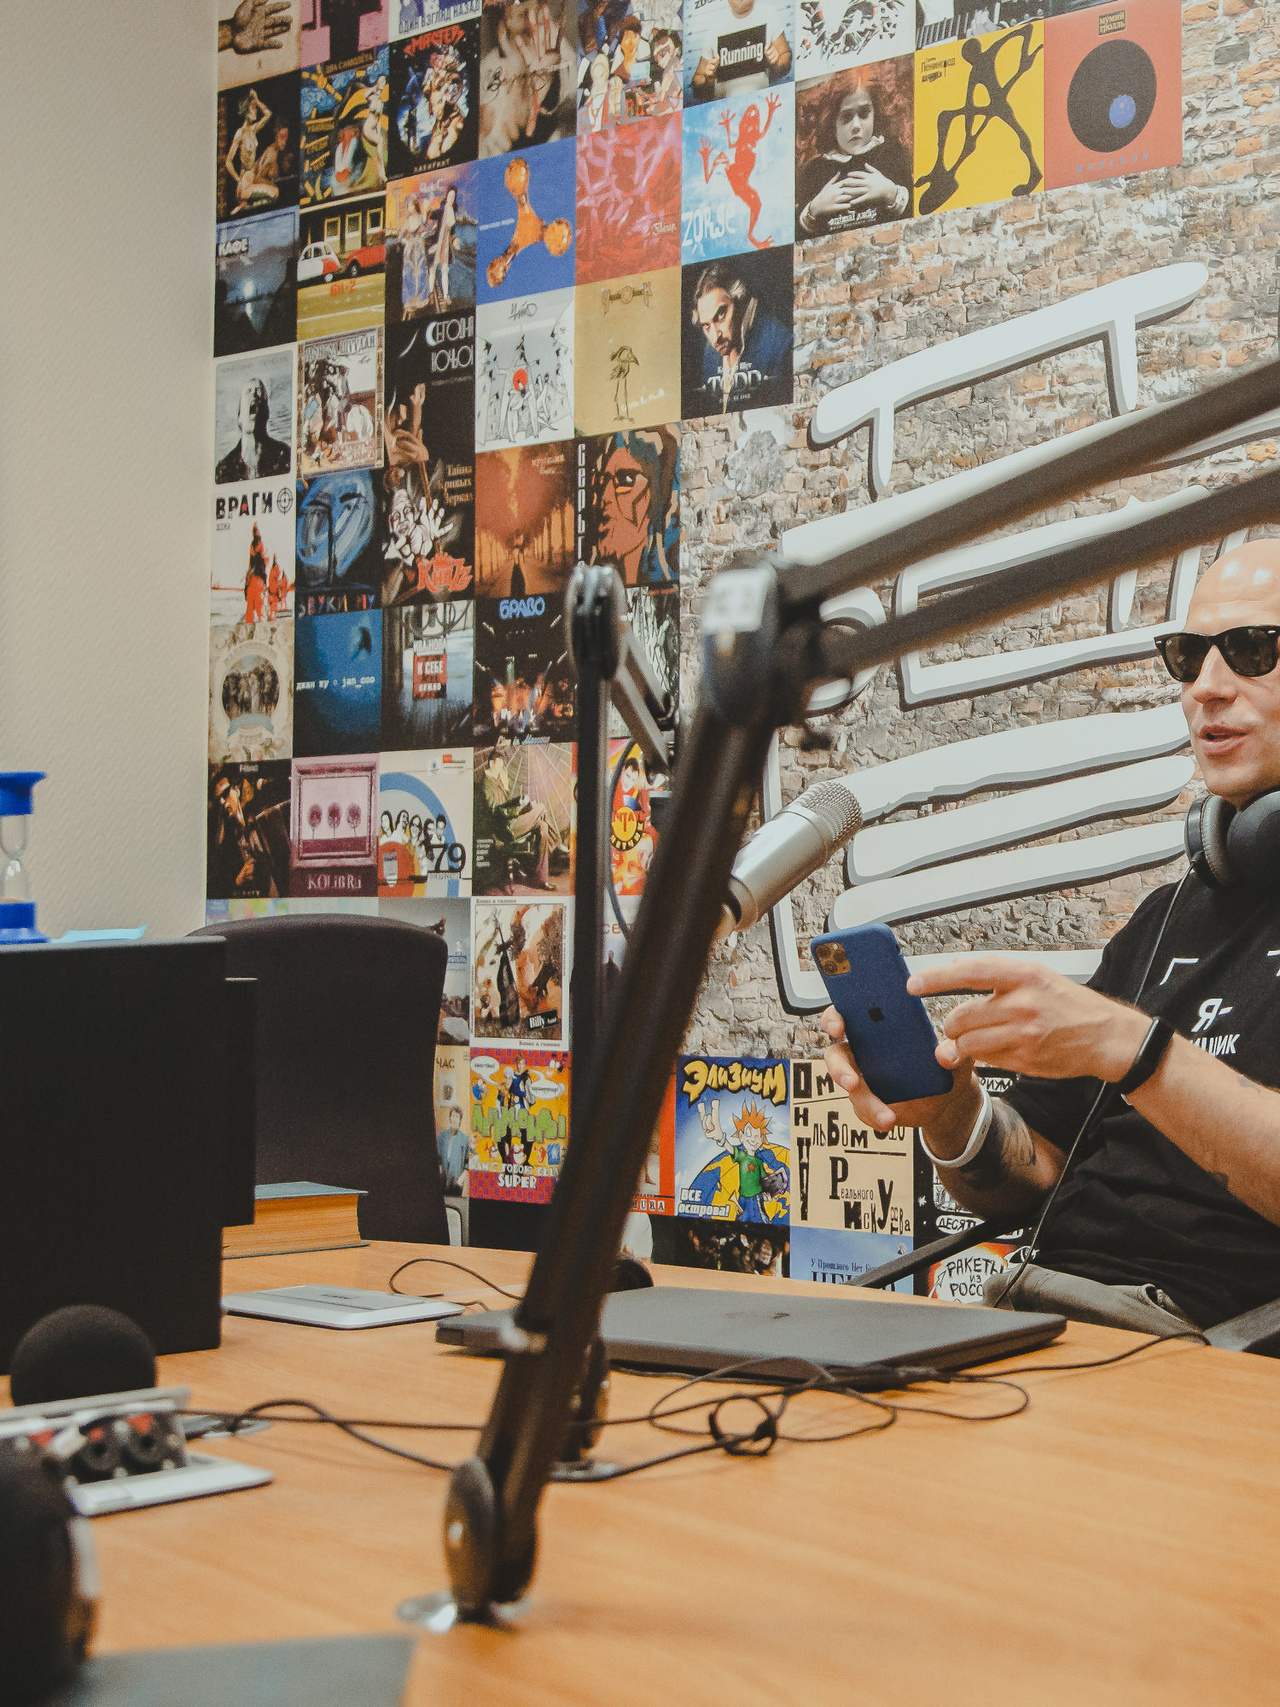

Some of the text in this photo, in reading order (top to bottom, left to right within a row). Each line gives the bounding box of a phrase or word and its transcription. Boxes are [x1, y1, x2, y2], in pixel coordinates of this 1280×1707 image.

[719, 41, 764, 67] Running
[215, 491, 273, 520] ВРАГИ
[497, 1174, 538, 1190] SUPER
[679, 1187, 703, 1202] ВСЕ
[946, 1256, 1005, 1278] РАКЕТЫ
[969, 1275, 982, 1284] ИЗ
